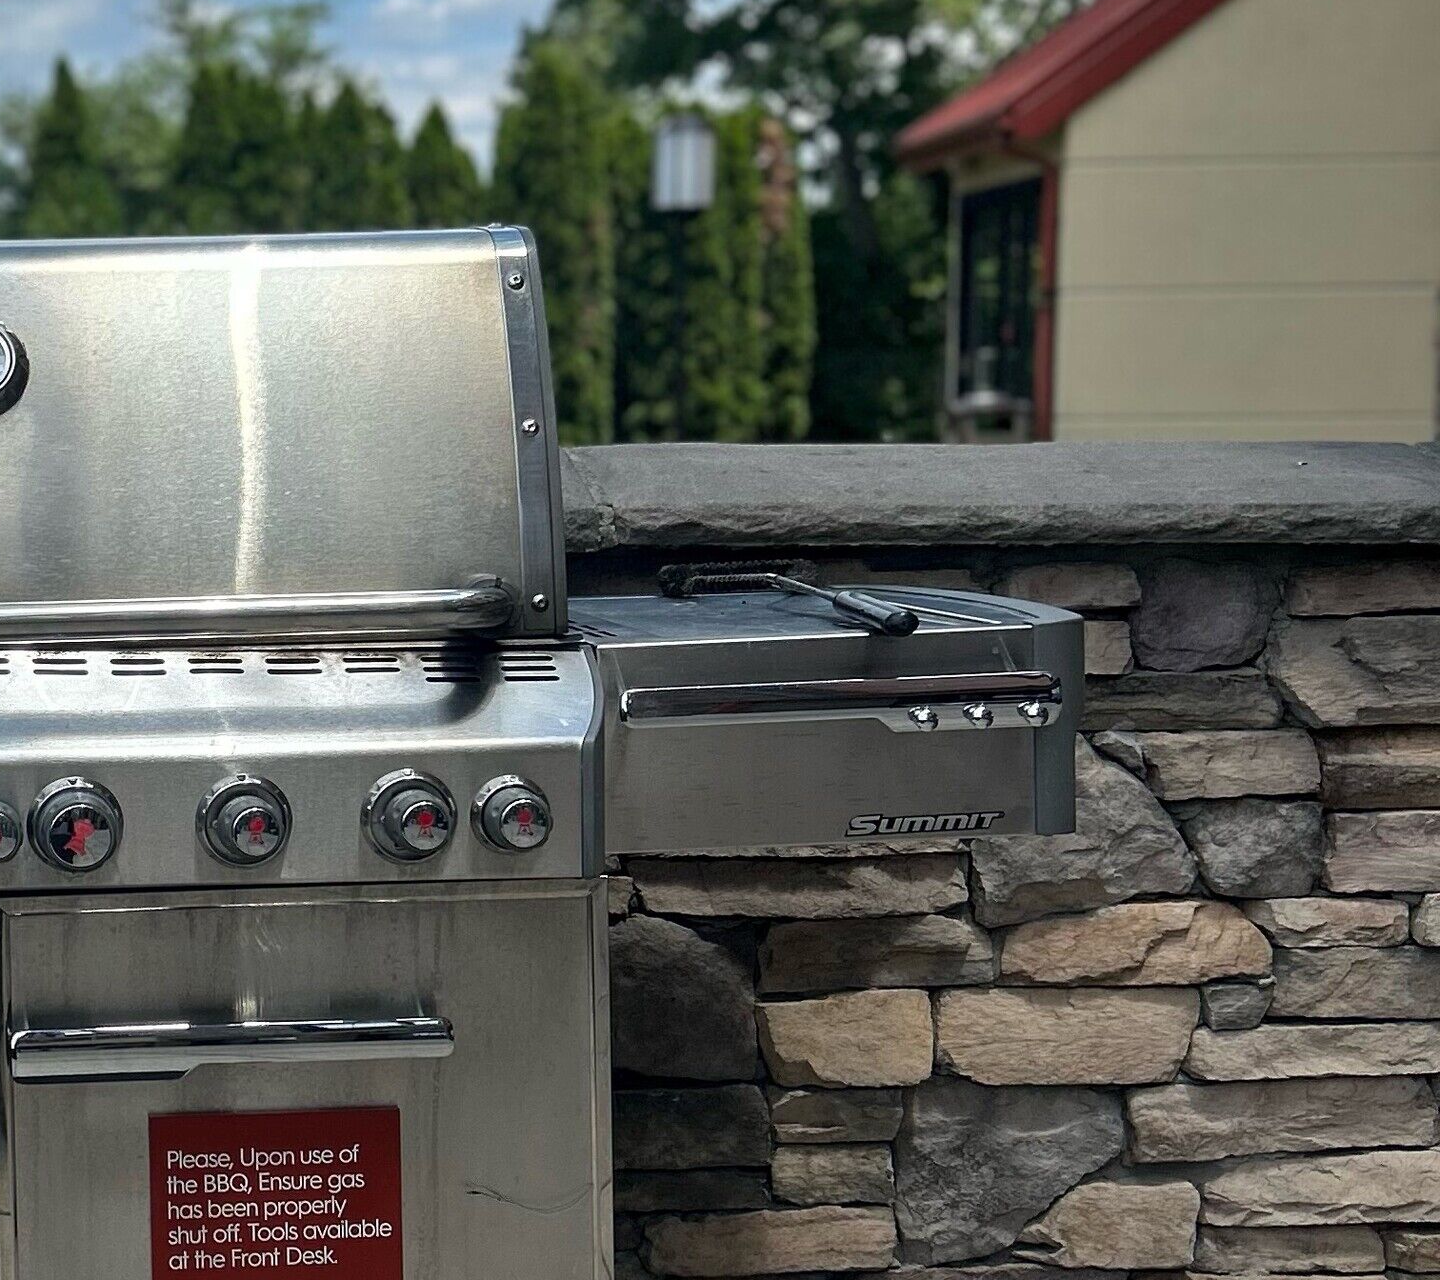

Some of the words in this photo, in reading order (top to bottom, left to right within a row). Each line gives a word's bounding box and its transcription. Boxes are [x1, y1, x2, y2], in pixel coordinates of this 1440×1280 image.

[167, 1150, 234, 1170] Please,
[240, 1147, 294, 1170] Upon
[300, 1148, 333, 1164] use
[339, 1144, 359, 1163] of
[167, 1176, 197, 1194] the
[204, 1174, 252, 1194] BBQ,
[259, 1172, 322, 1192] Ensure
[328, 1173, 365, 1193] gas
[167, 1201, 202, 1220] has
[208, 1200, 258, 1218] been
[264, 1195, 346, 1220] properly
[168, 1226, 208, 1245] shut
[213, 1224, 243, 1243] off.
[248, 1222, 298, 1241] Tools
[303, 1219, 392, 1240] available
[169, 1251, 189, 1270] at
[194, 1250, 225, 1268] the
[231, 1247, 280, 1267] Front
[286, 1246, 338, 1266] Desk.
